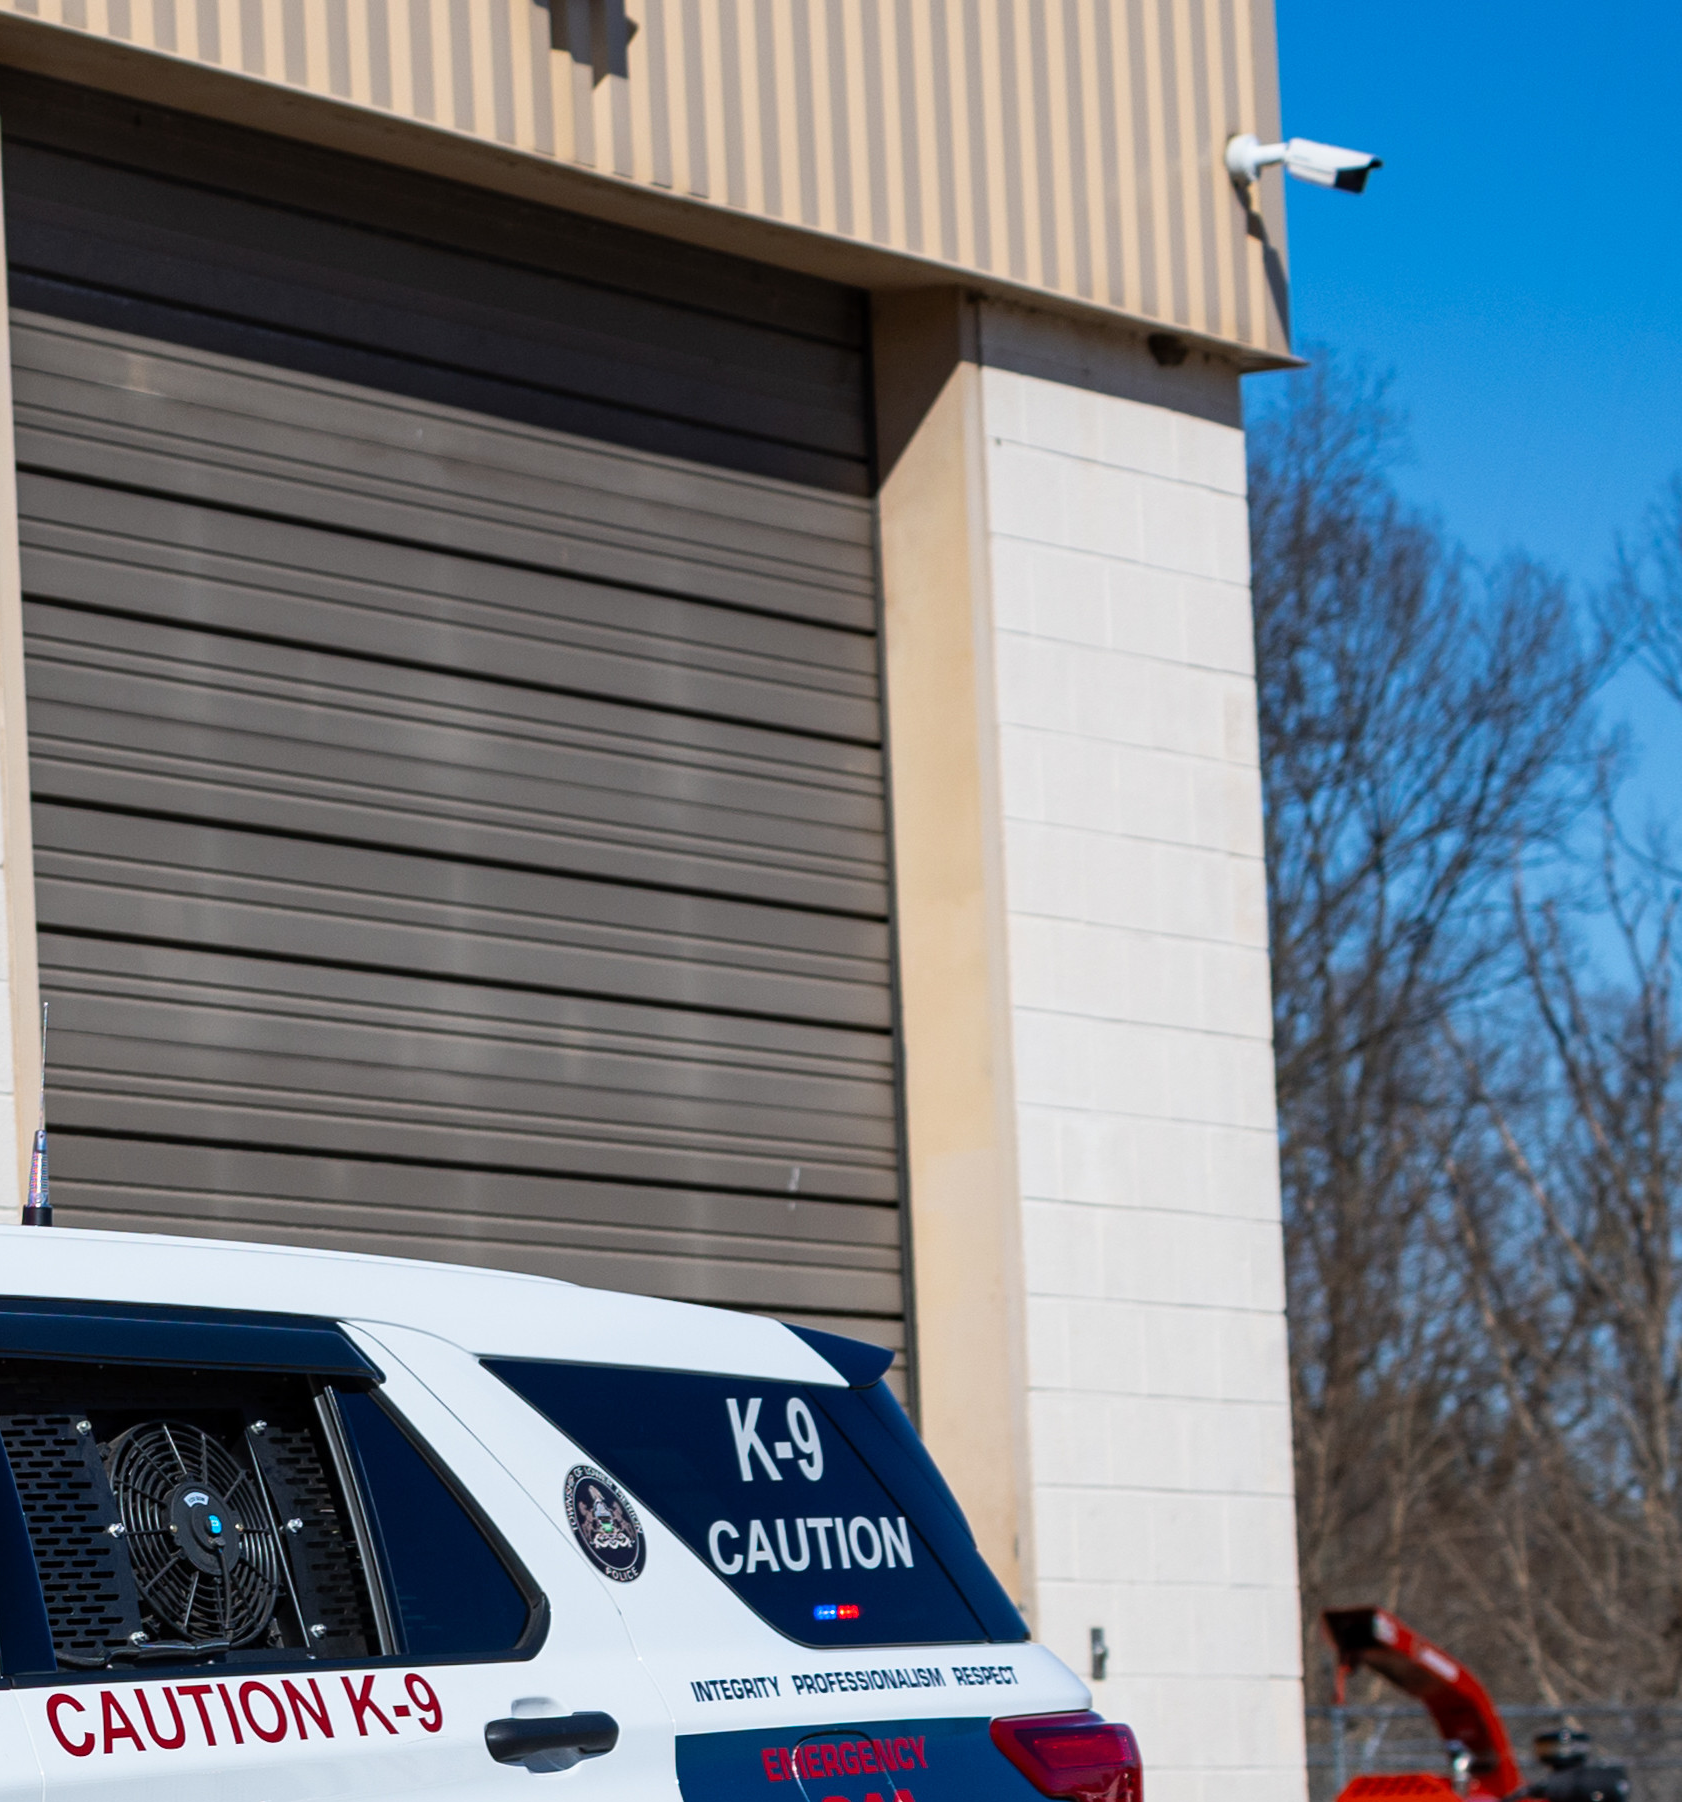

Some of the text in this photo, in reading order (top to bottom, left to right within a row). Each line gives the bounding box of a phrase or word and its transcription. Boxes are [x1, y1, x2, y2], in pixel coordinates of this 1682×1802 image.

[726, 1397, 824, 1482] K-9
[708, 1516, 914, 1575] CAUTION
[605, 1566, 639, 1581] POLICE
[690, 1666, 1019, 1703] INTEGRITY PROFESSIONALISM RESPECT
[46, 1673, 443, 1757] CAUTION K-9
[761, 1736, 929, 1782] EMERGENCY
